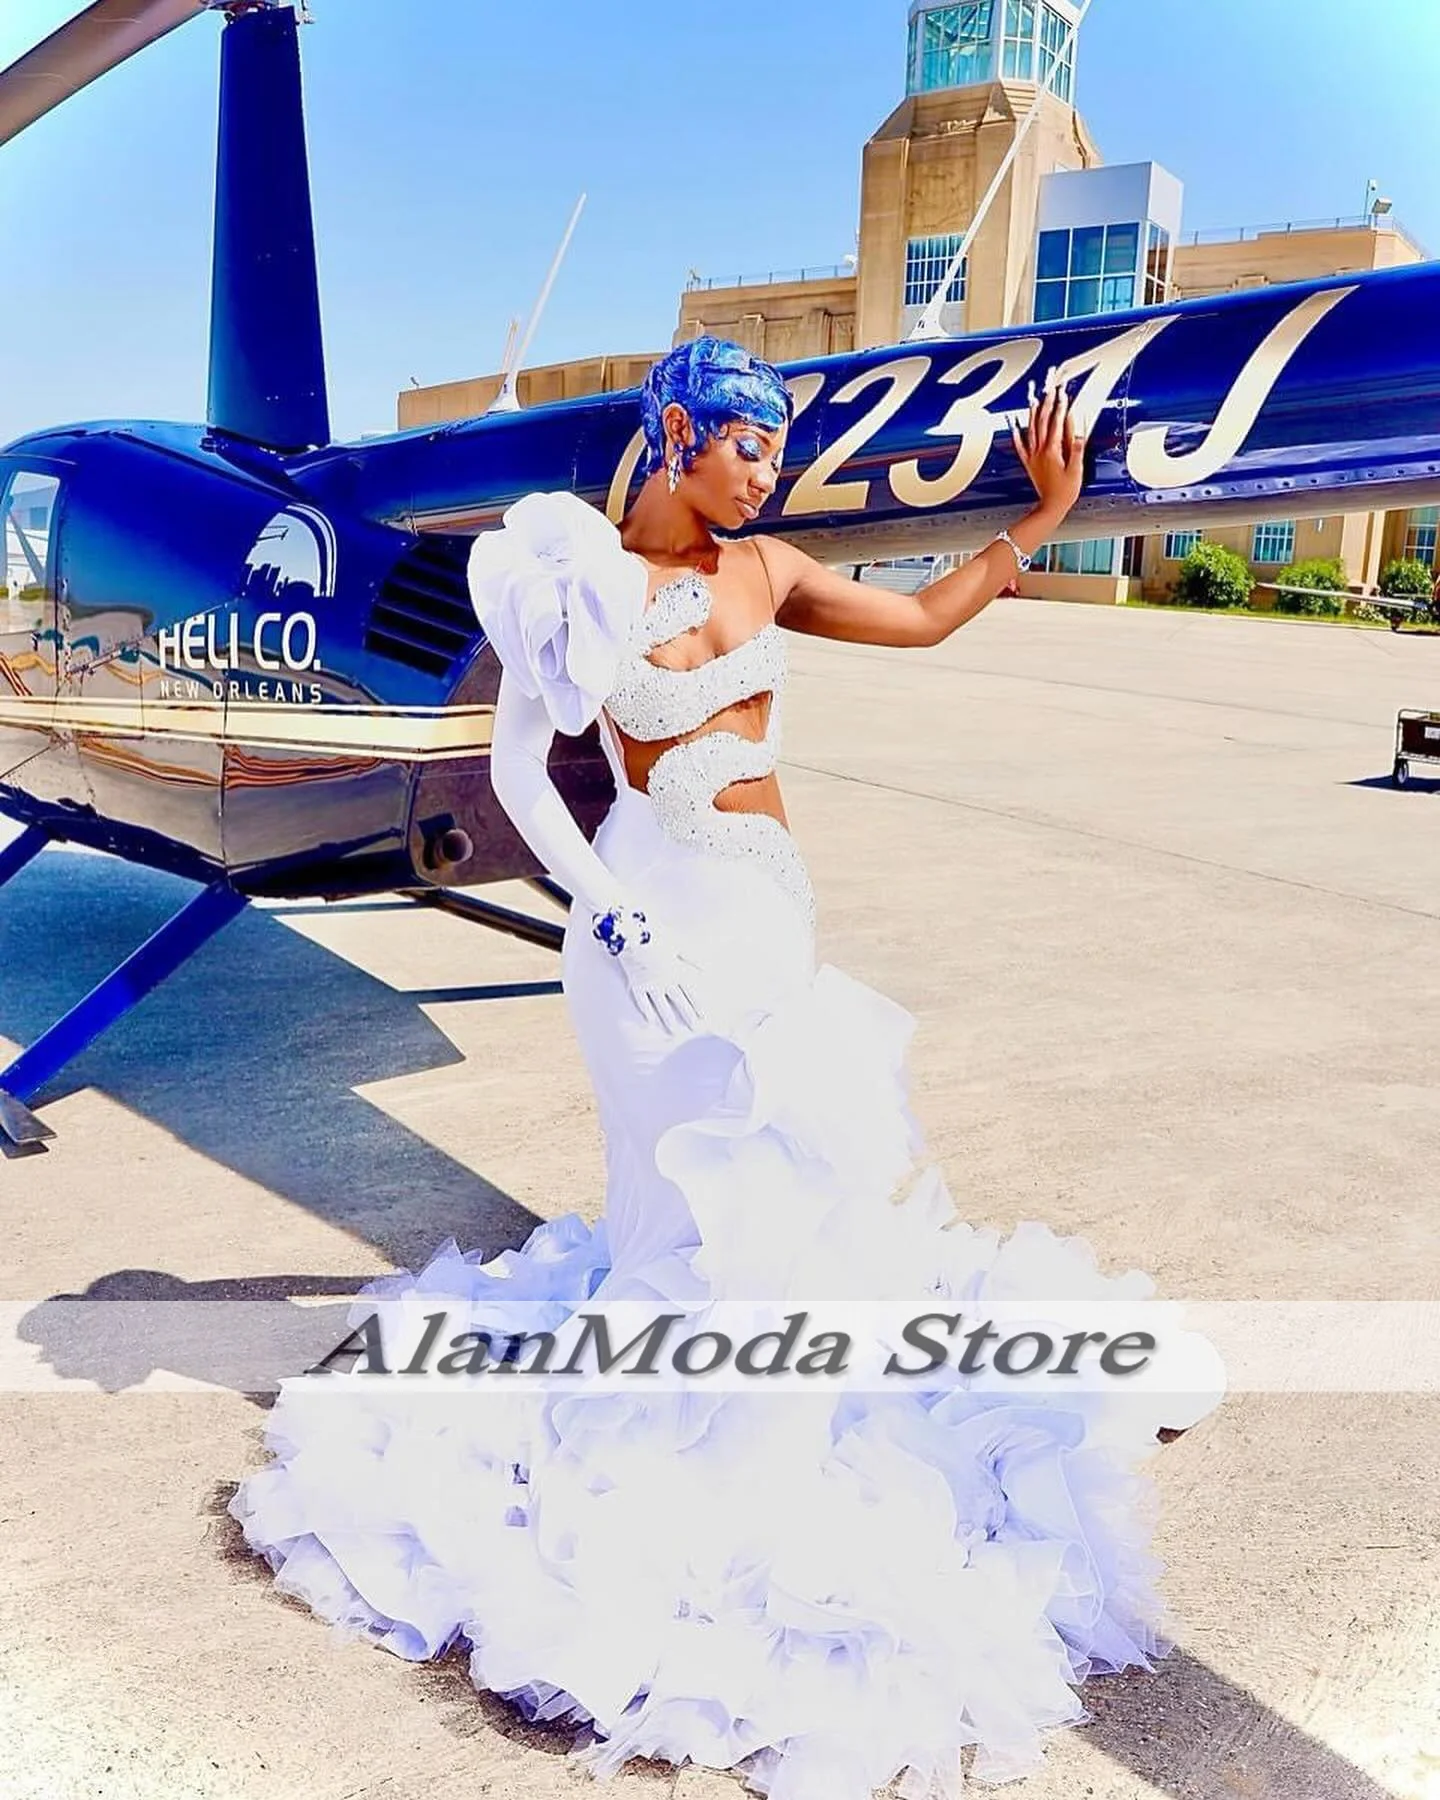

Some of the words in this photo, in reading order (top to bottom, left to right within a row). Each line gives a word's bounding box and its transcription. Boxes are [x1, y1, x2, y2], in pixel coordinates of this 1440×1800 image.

[158, 612, 240, 670] HELI
[253, 610, 322, 672] CO.
[160, 680, 199, 699] NEW
[212, 680, 323, 704] ORLEANS
